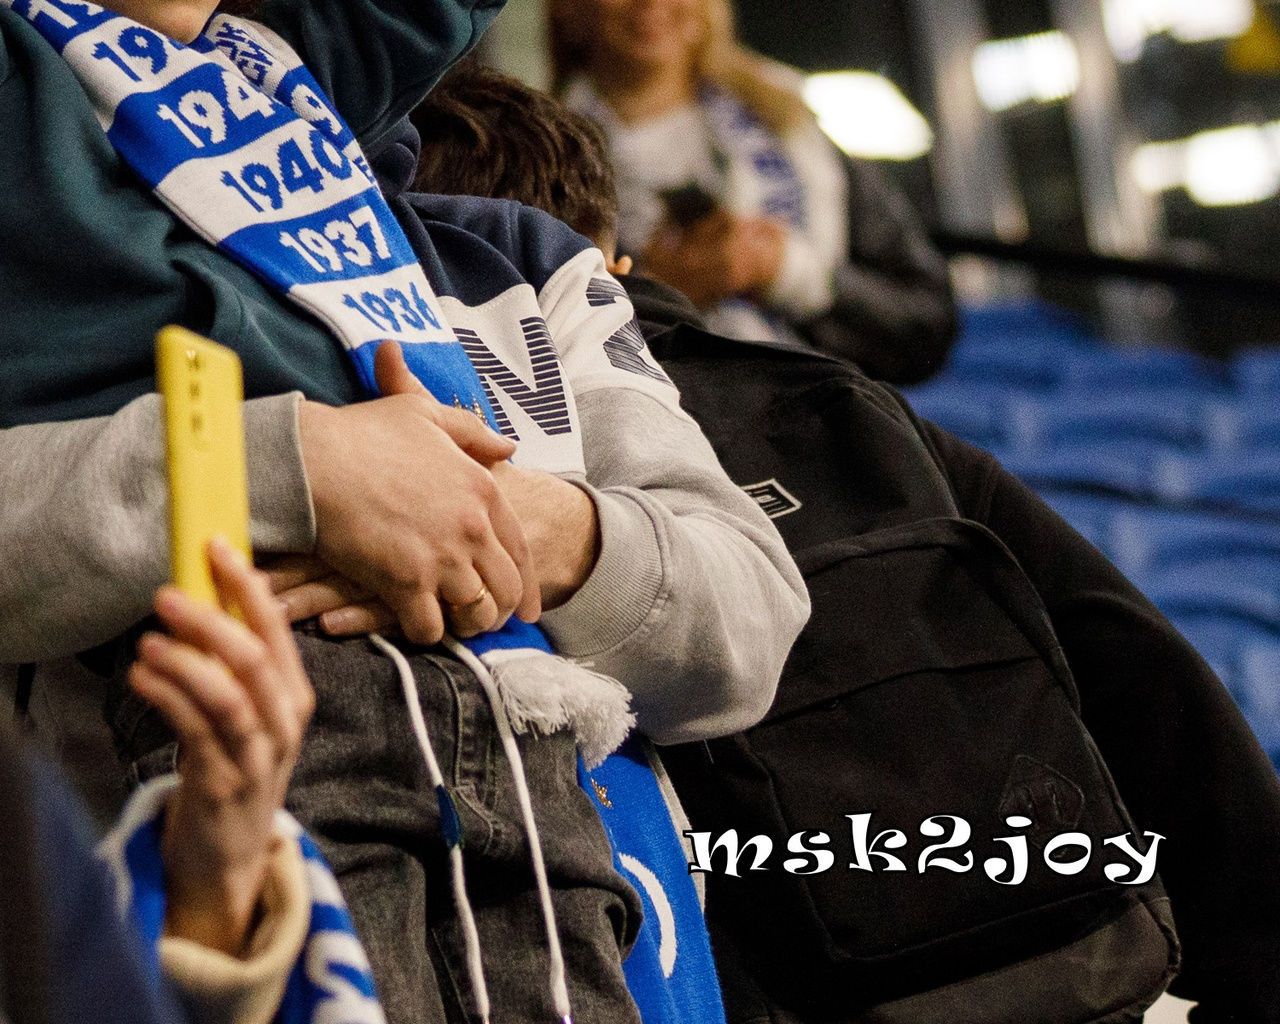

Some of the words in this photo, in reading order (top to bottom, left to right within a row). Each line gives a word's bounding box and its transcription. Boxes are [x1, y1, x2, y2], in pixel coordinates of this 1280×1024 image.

[156, 70, 276, 149] 194
[220, 129, 354, 214] 1940
[279, 205, 393, 274] 1937
[342, 282, 443, 334] 1936
